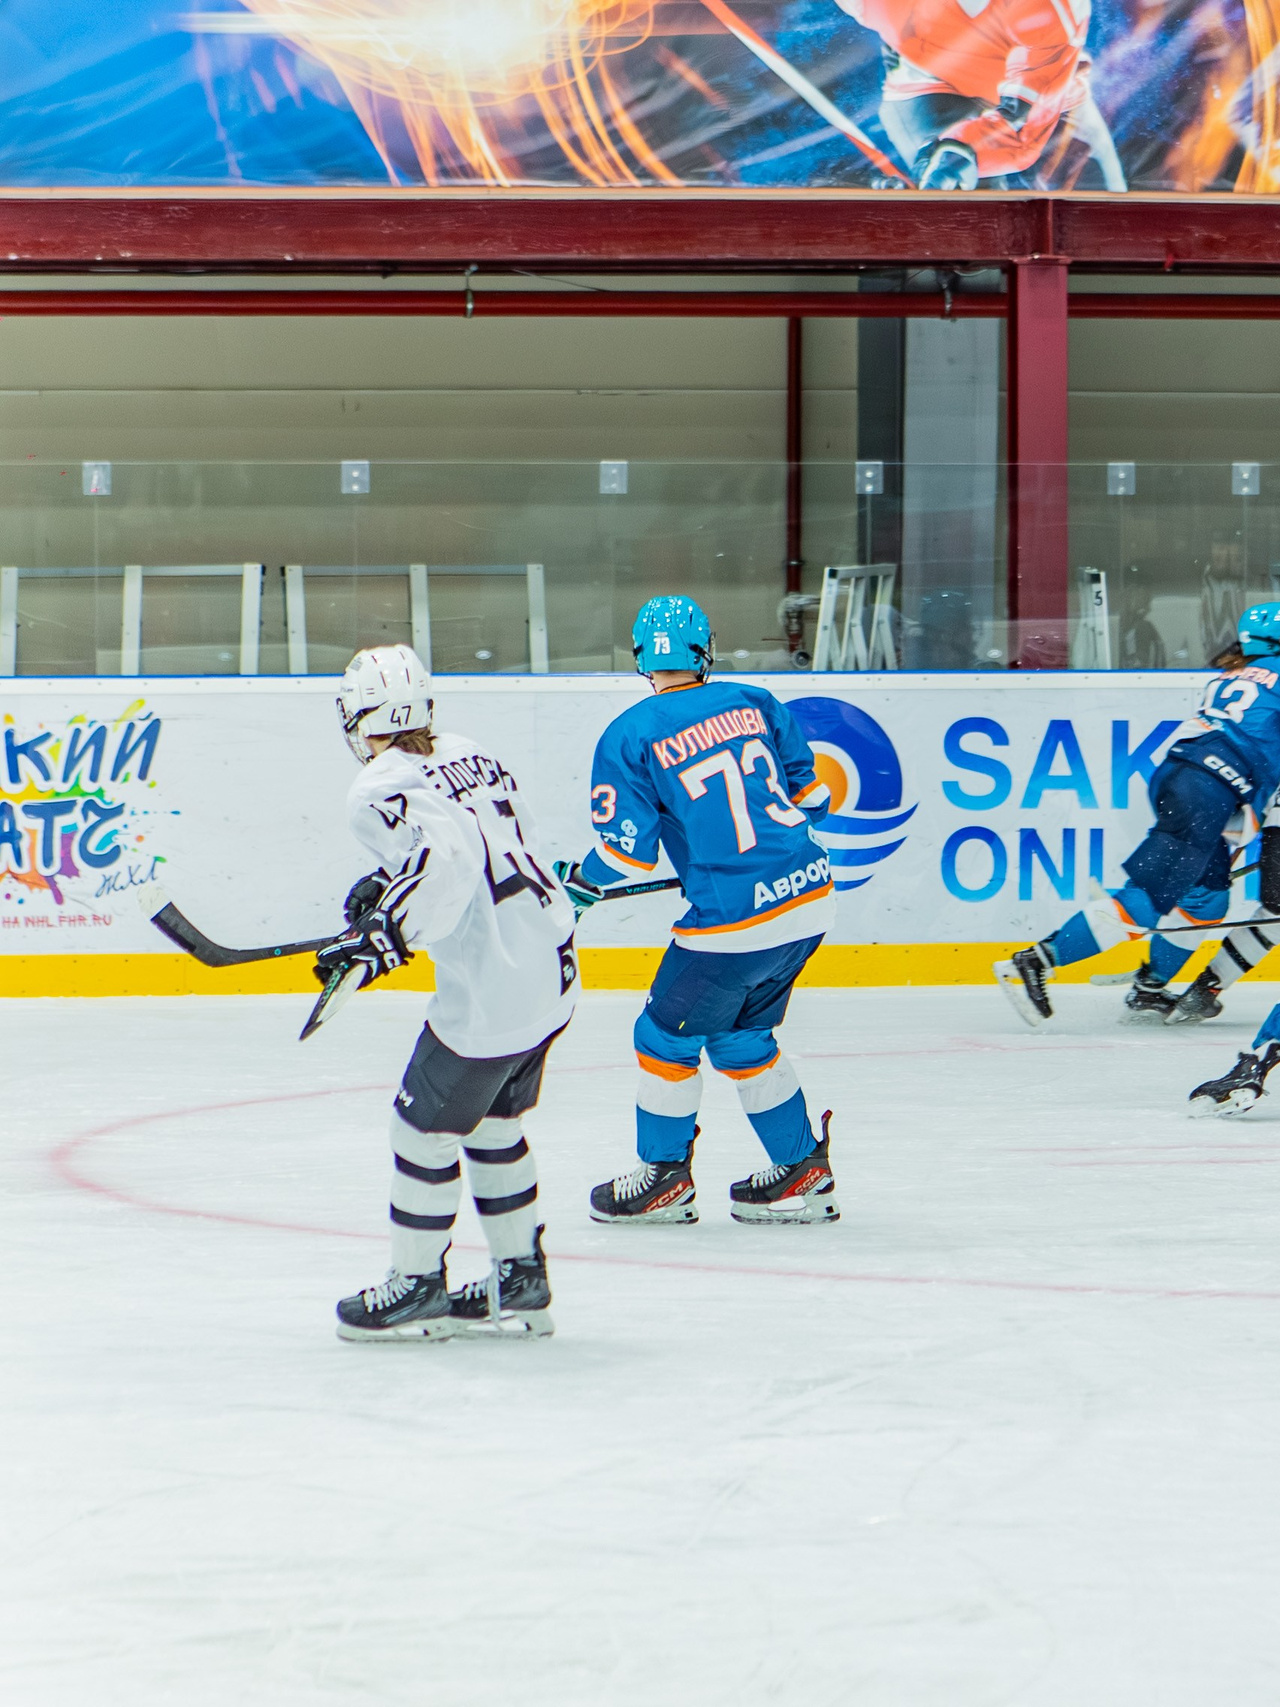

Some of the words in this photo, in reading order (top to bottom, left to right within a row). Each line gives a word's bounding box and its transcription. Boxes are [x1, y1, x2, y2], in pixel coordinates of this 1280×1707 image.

[653, 636, 671, 655] 73
[390, 705, 412, 727] 47
[652, 707, 768, 770] КУЛИШОВА
[1203, 755, 1253, 795] CCM
[678, 738, 807, 855] 73
[754, 855, 830, 910] Аврор
[794, 1170, 821, 1194] CCM
